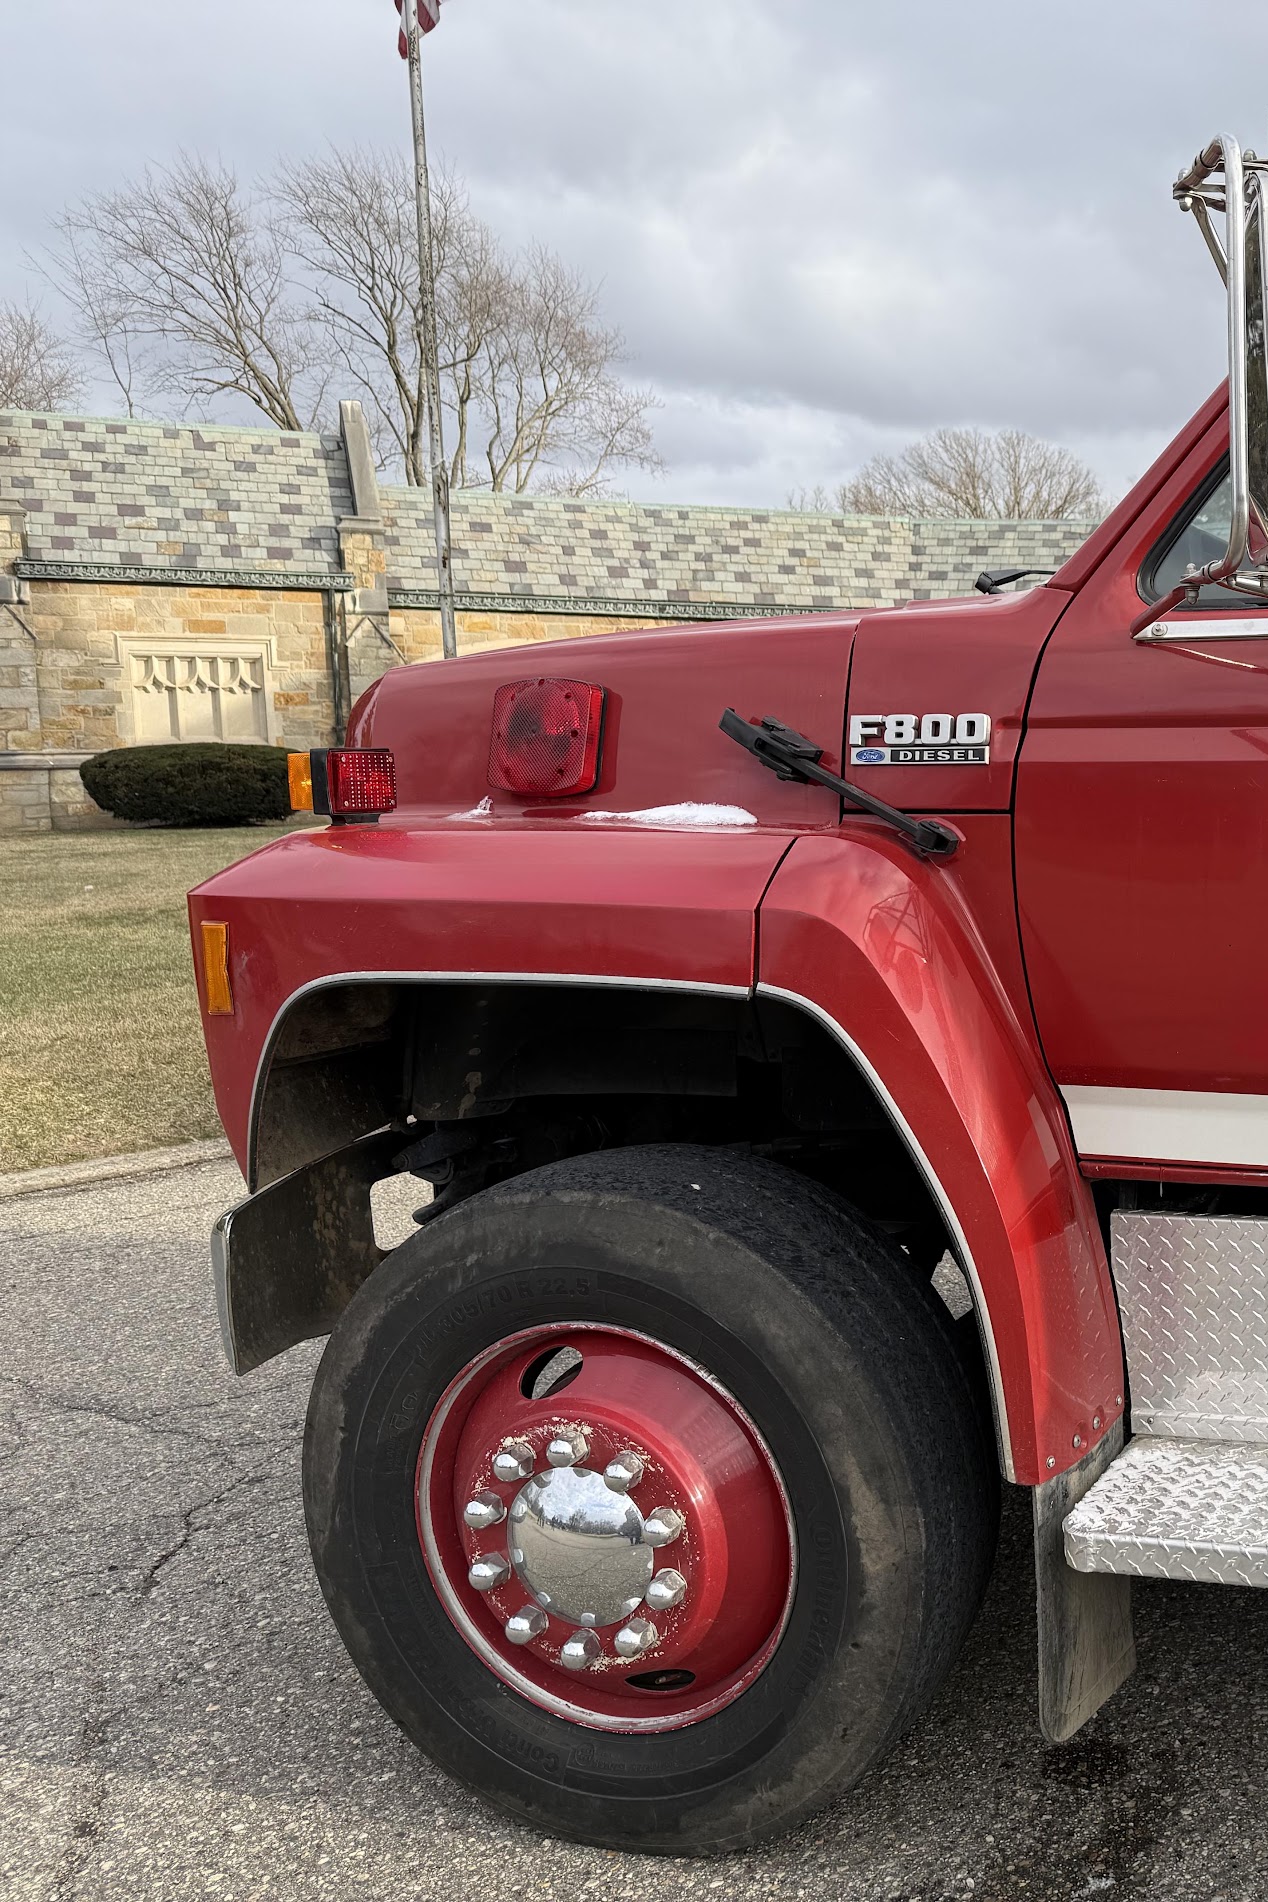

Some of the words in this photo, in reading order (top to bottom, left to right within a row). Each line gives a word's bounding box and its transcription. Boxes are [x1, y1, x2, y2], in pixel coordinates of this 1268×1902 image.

[849, 713, 992, 746] F800
[899, 749, 980, 761] DIESEL
[537, 1278, 592, 1297] 22.5
